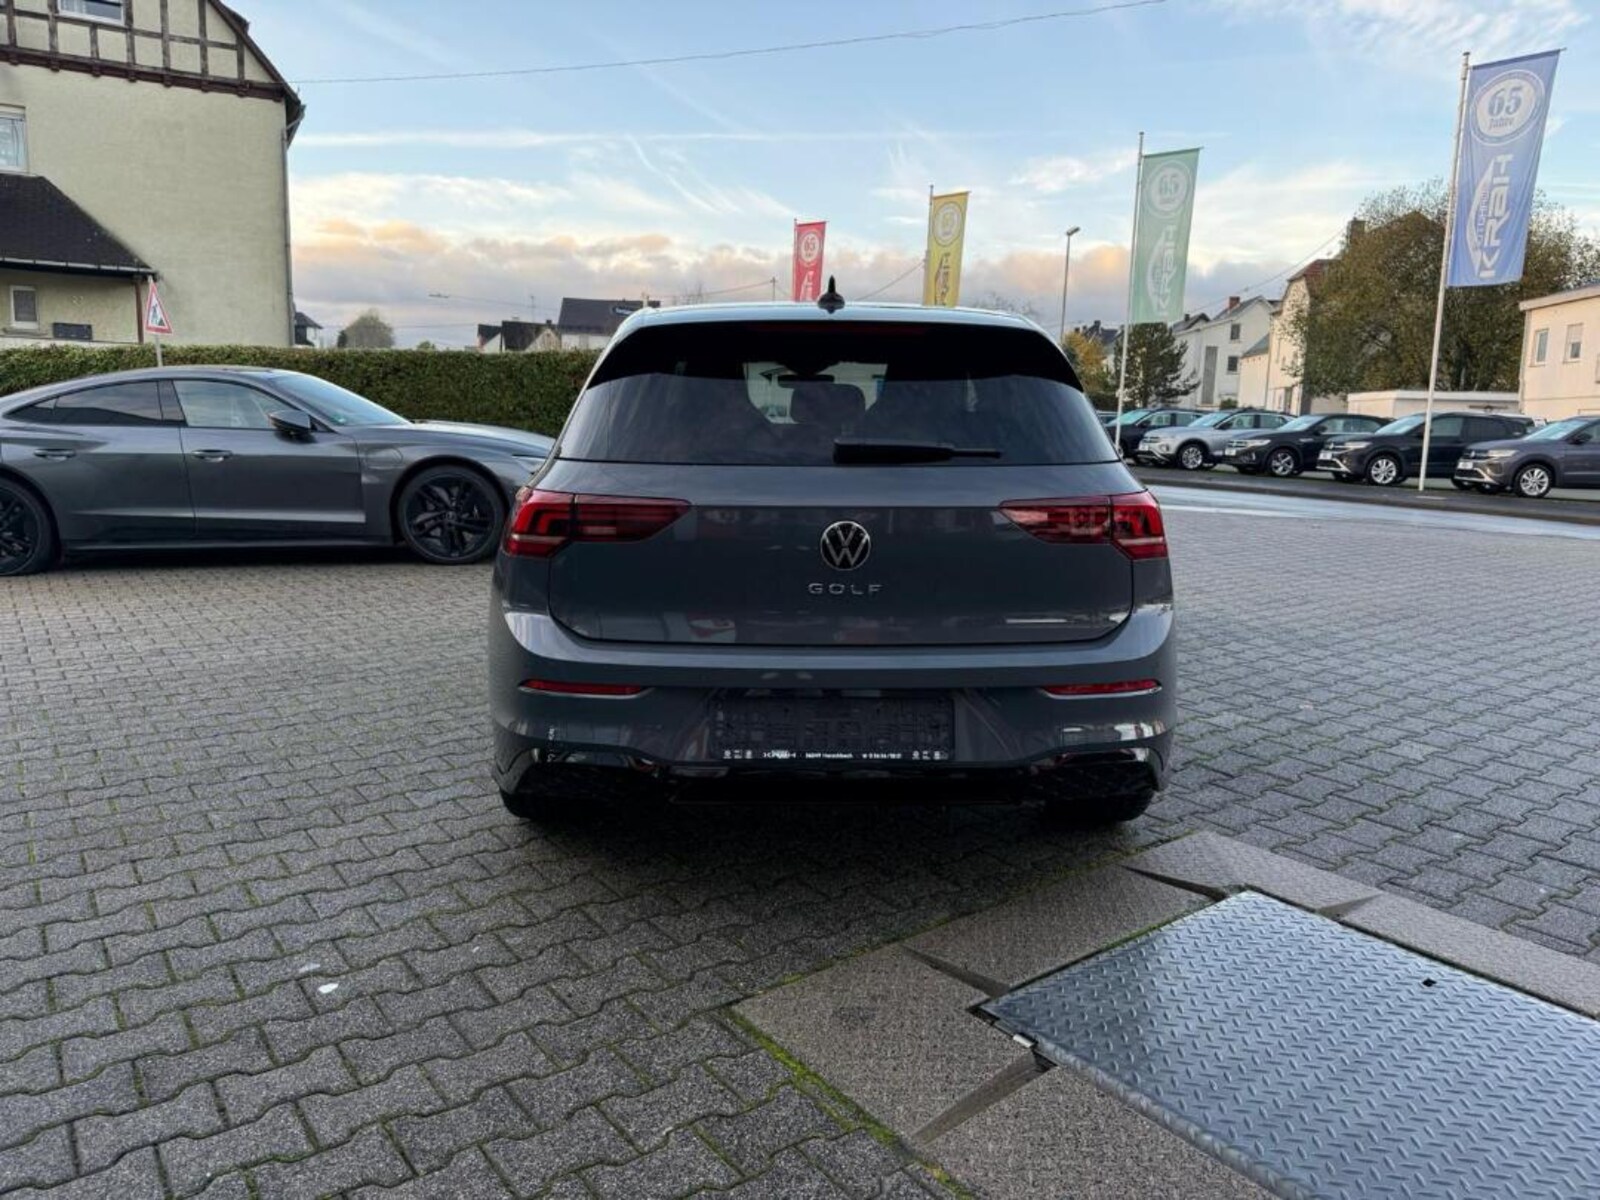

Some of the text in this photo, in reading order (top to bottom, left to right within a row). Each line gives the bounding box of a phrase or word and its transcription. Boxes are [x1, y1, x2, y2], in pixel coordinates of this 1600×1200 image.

[1487, 86, 1523, 117] 65
[821, 521, 871, 571] VW
[808, 583, 882, 595] GOLF
